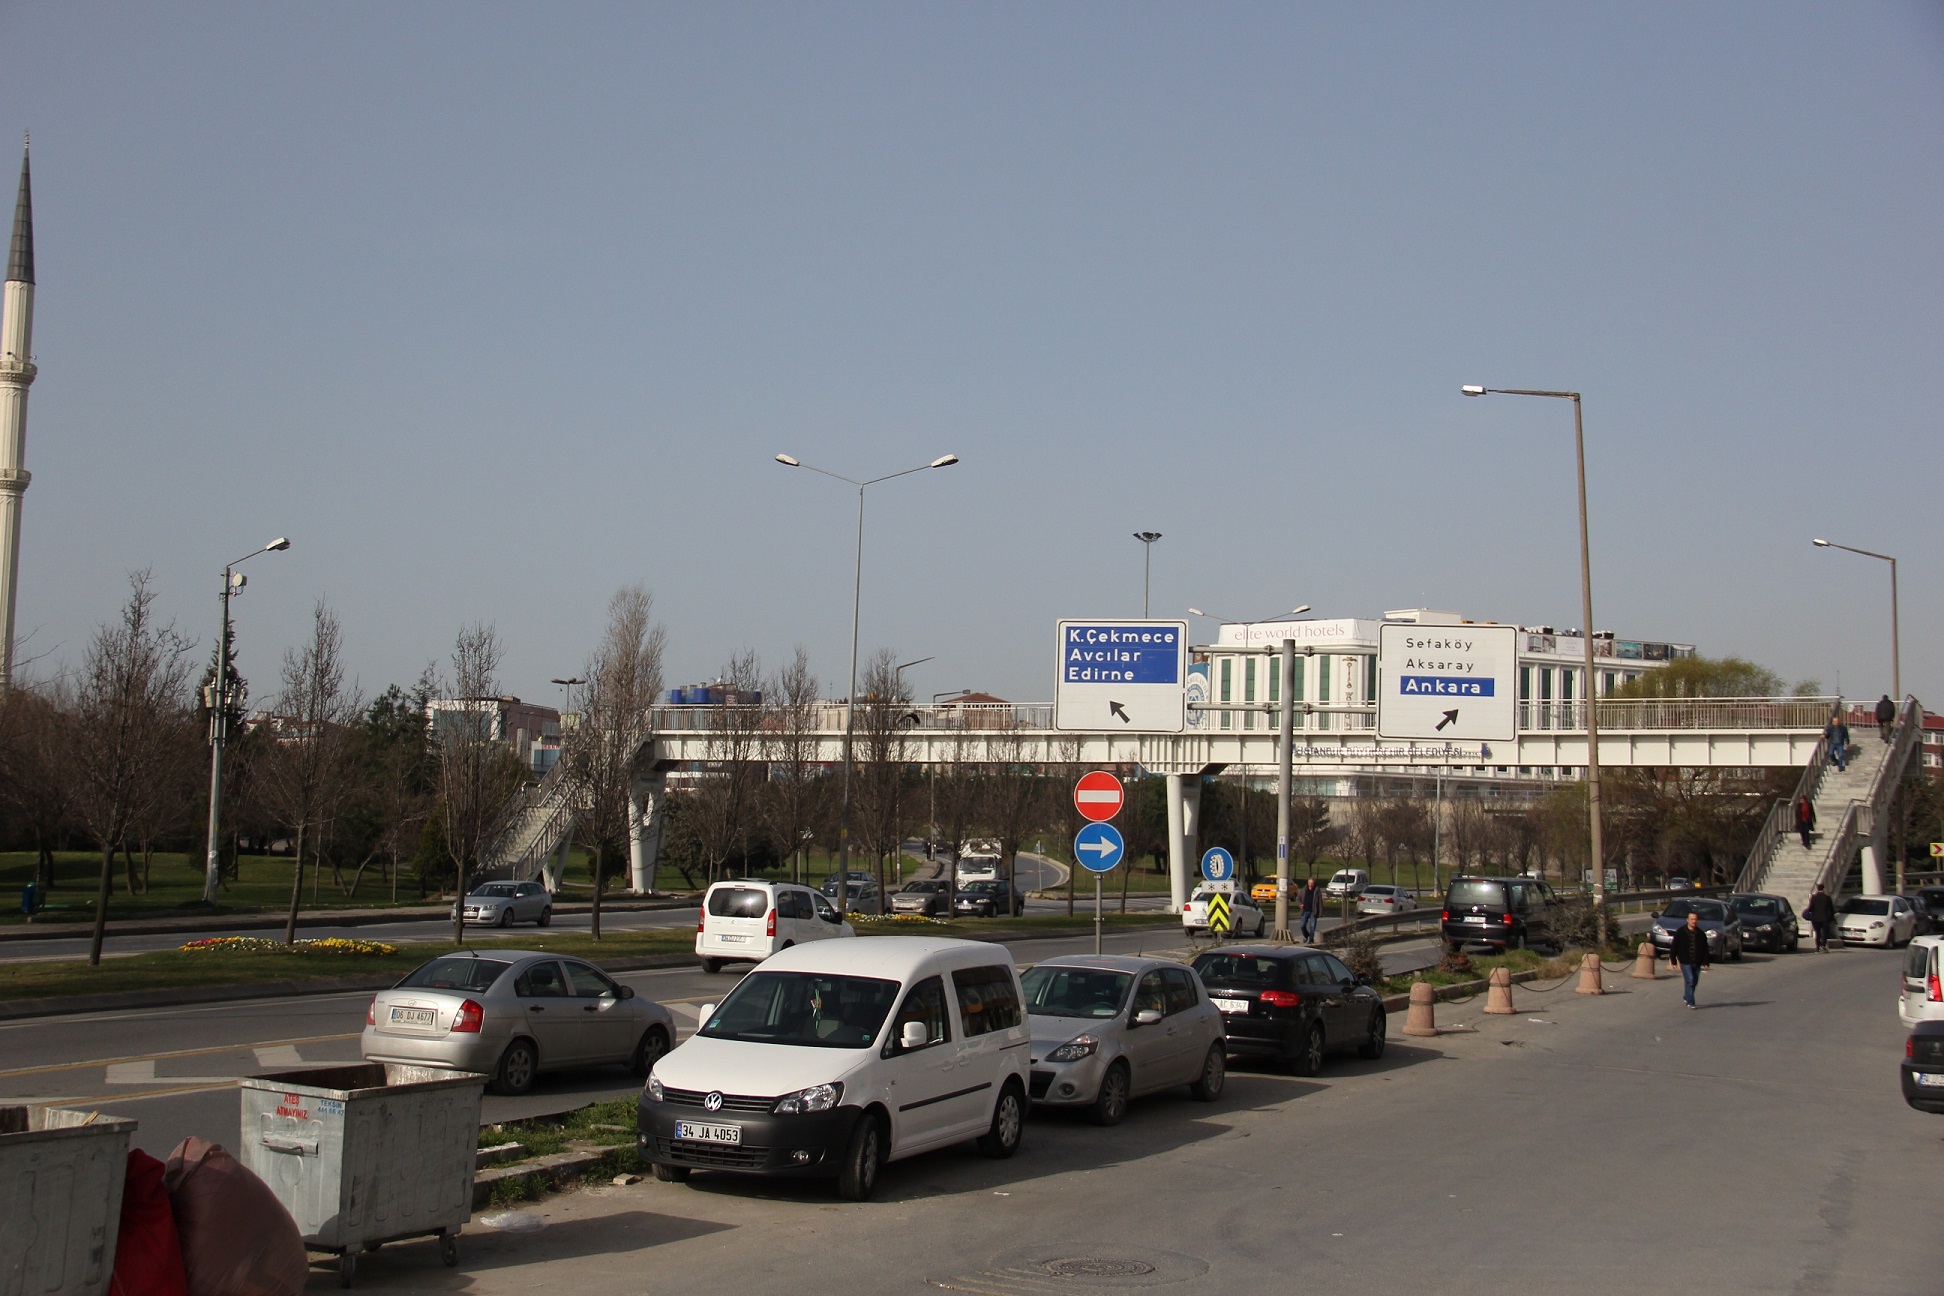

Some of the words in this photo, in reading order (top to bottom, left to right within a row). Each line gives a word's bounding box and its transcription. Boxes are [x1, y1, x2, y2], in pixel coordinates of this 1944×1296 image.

[1069, 629, 1175, 645] K.Çekmece
[1234, 628, 1262, 641] elte
[1265, 625, 1301, 639] world
[1304, 623, 1345, 637] hotels
[1406, 637, 1473, 652] Sefaköy
[1069, 648, 1142, 662] Avcılar
[1405, 658, 1474, 673] Aksaray
[1068, 667, 1135, 681] Edirne
[1405, 678, 1481, 694] Ankara
[682, 1124, 694, 1138] 34
[698, 1126, 710, 1139] JA
[714, 1128, 738, 1141] 4053
